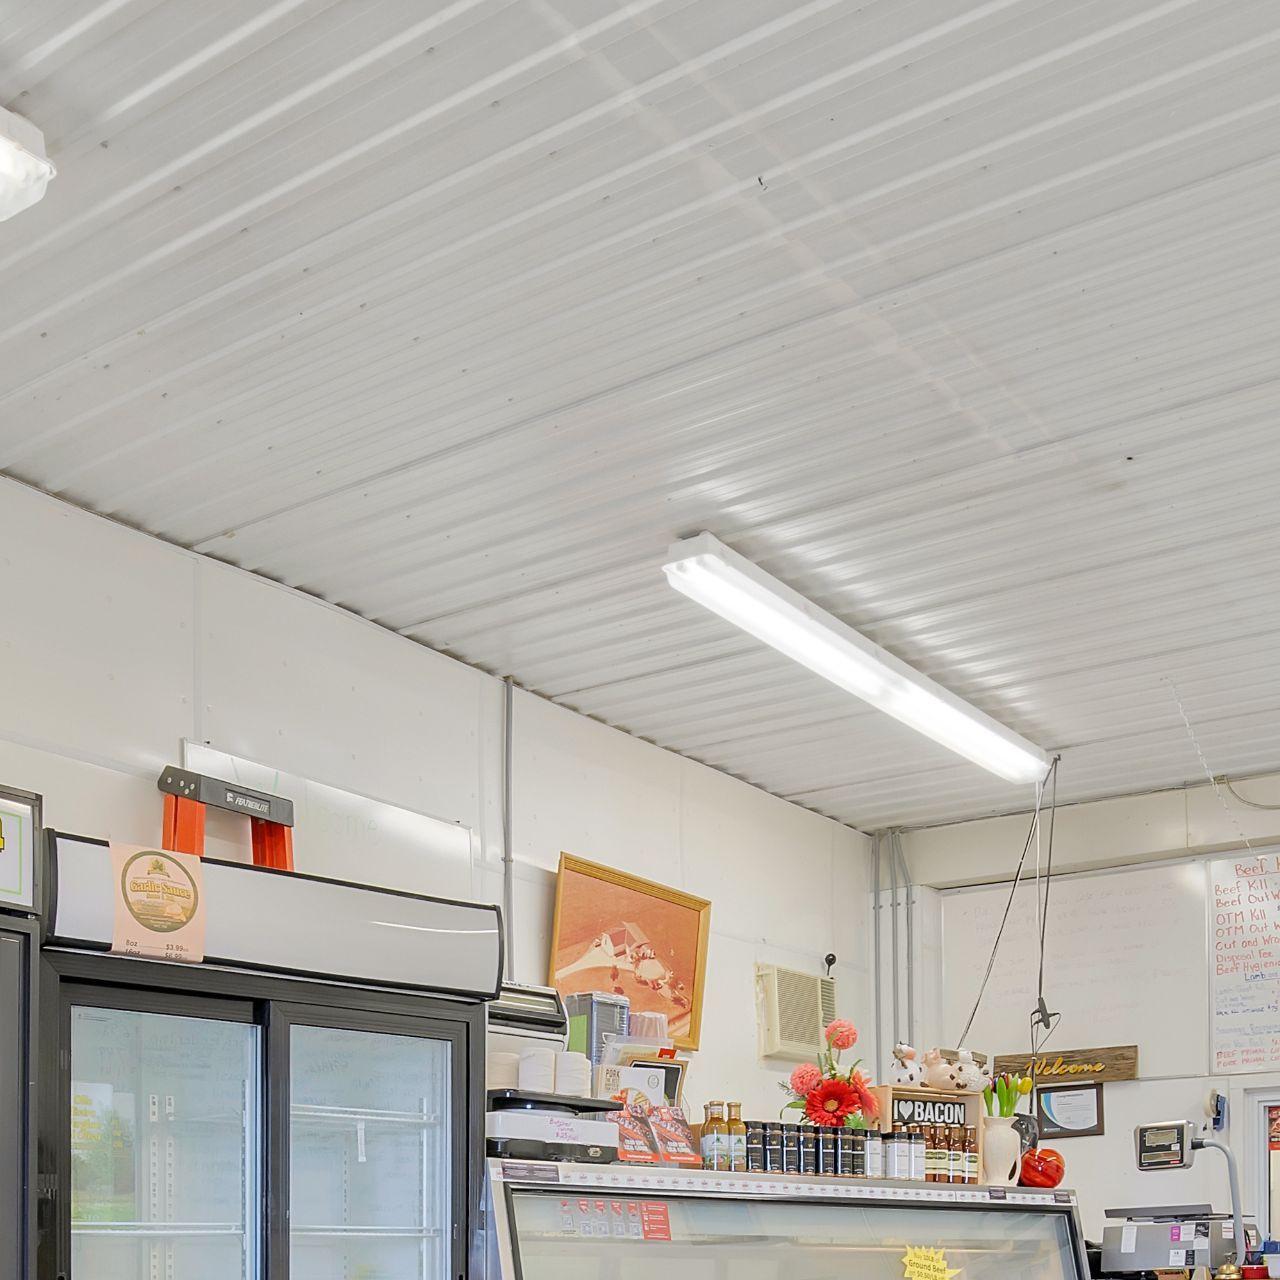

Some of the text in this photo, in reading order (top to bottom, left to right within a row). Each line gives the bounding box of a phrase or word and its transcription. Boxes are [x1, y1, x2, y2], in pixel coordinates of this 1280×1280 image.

[235, 798, 269, 813] FEATHERLITE
[1235, 858, 1268, 875] Beef
[130, 881, 191, 899] Garlic Sauce
[1215, 879, 1267, 896] Beef Kill
[1216, 896, 1240, 908] Beef
[1248, 892, 1269, 903] Out
[1216, 910, 1266, 925] OTM Kill
[1216, 925, 1244, 938] OTM
[1250, 923, 1269, 933] Out
[1216, 941, 1236, 950] Cut
[1242, 940, 1257, 948] and
[1217, 950, 1273, 967] Disposal Fee
[1217, 963, 1240, 975] Beef
[1244, 960, 1280, 971] Hygienic
[1245, 973, 1266, 981] Lamb
[1026, 1057, 1105, 1075] Welcome
[914, 1101, 965, 1124] BACON
[909, 1260, 946, 1274] Ground Beef
